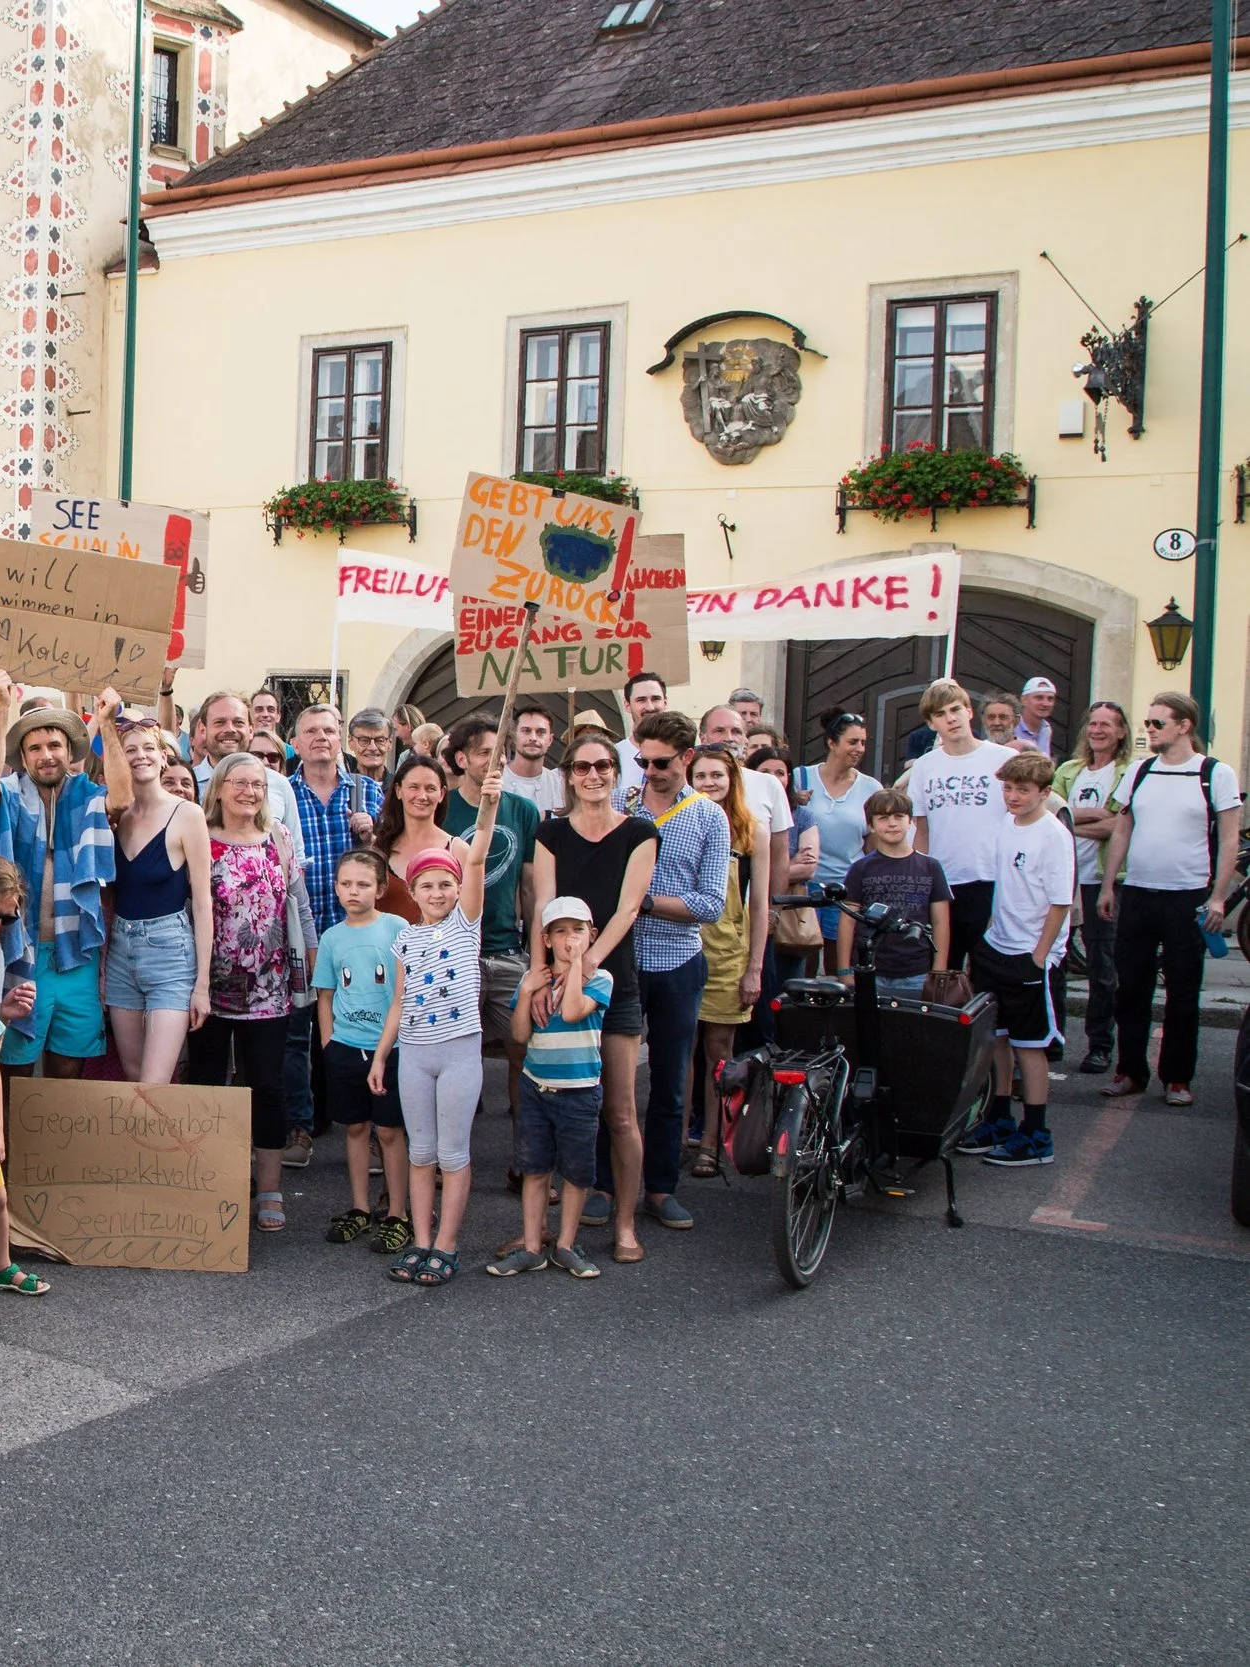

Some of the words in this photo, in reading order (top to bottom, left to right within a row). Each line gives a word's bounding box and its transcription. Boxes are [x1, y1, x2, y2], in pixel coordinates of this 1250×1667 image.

[52, 499, 100, 530] SEE
[469, 475, 552, 519] GEBT
[554, 498, 614, 535] UNS
[462, 513, 527, 557] DEN
[1170, 532, 1181, 551] 8
[6, 558, 78, 593] will
[338, 565, 449, 602] FREILUF
[93, 603, 119, 625] in
[686, 591, 738, 614] EIN
[928, 791, 988, 811] JONES
[19, 1093, 100, 1149] Gegen
[103, 1096, 227, 1136] Badeverbot
[82, 1151, 217, 1193] respektvolle
[58, 1196, 208, 1244] Seenutzung
